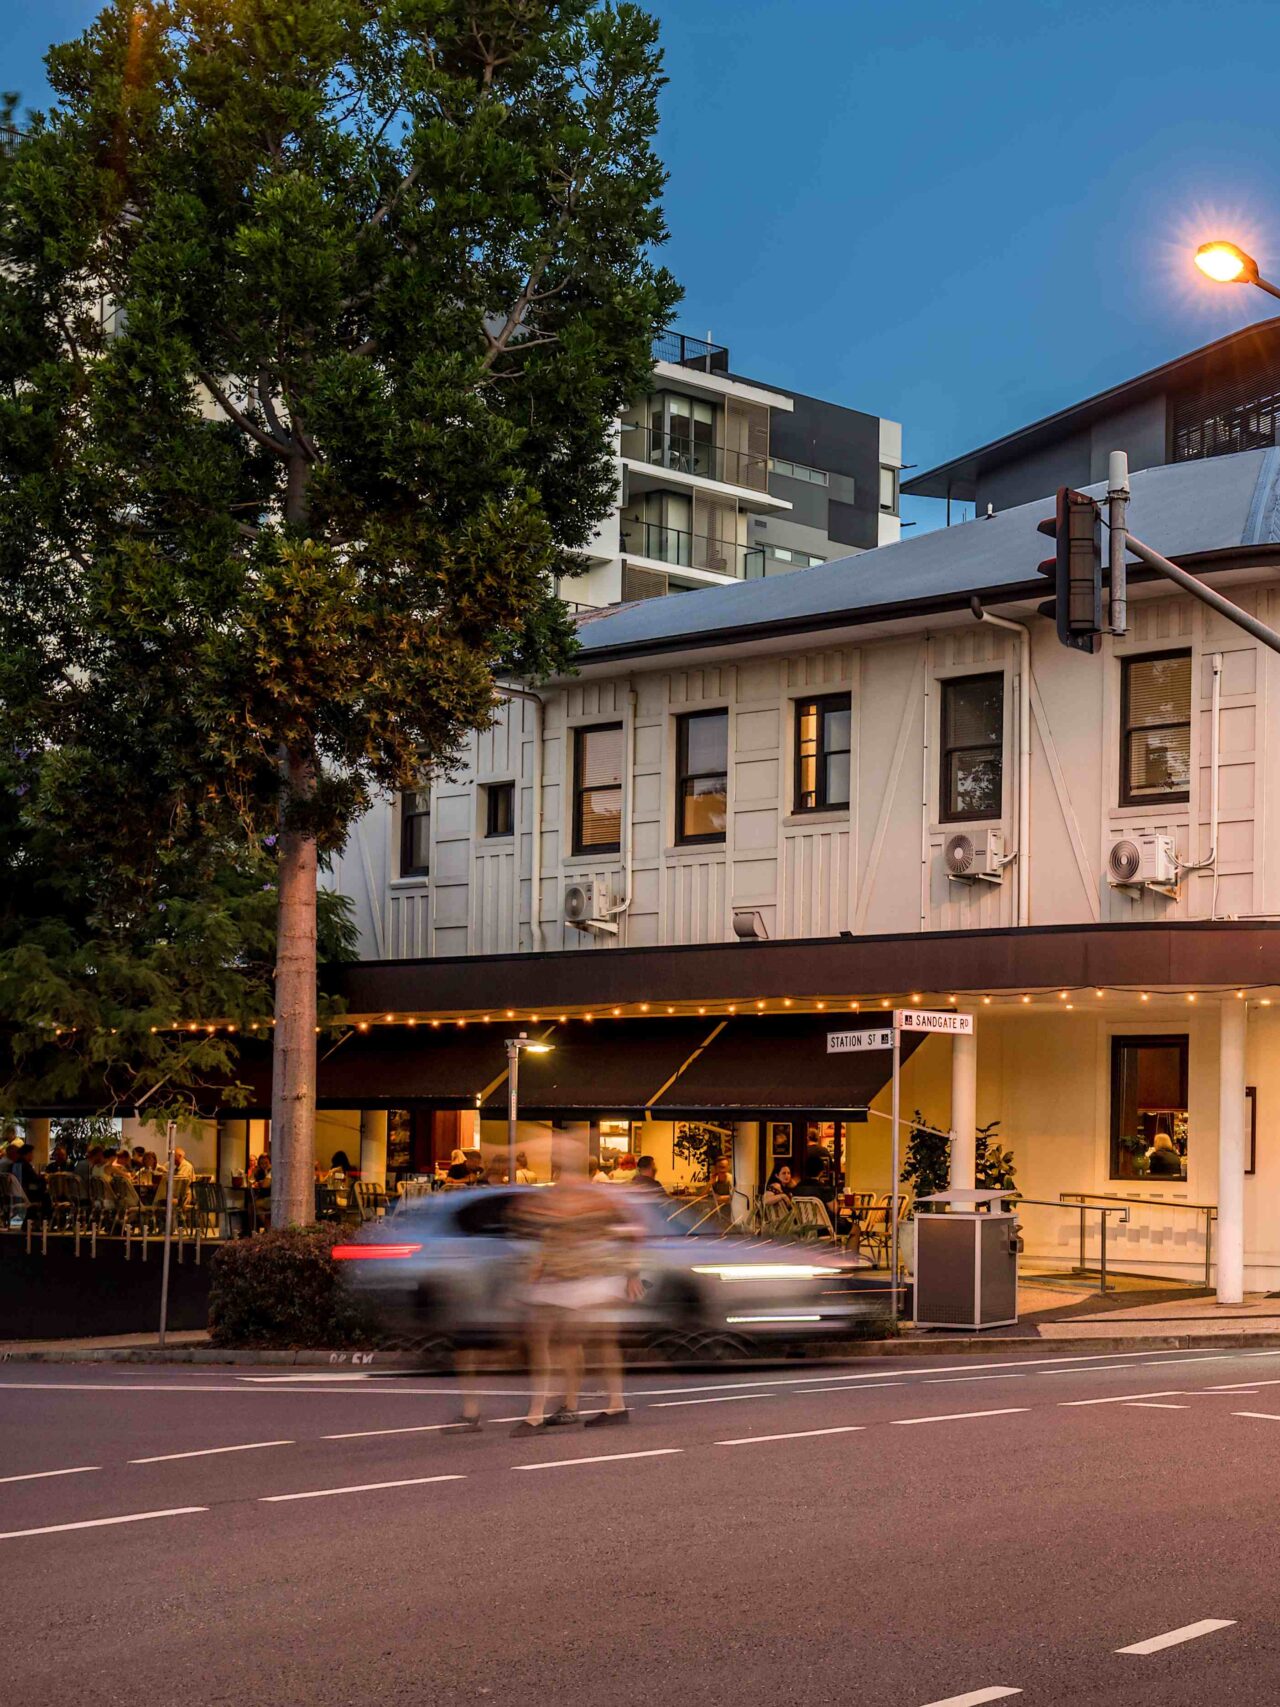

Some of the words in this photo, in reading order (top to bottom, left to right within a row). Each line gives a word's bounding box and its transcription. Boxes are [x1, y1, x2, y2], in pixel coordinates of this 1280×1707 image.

[916, 1015, 957, 1029] SANDGATE
[959, 1018, 969, 1029] RD
[831, 1034, 862, 1048] STATION
[868, 1034, 876, 1045] ST
